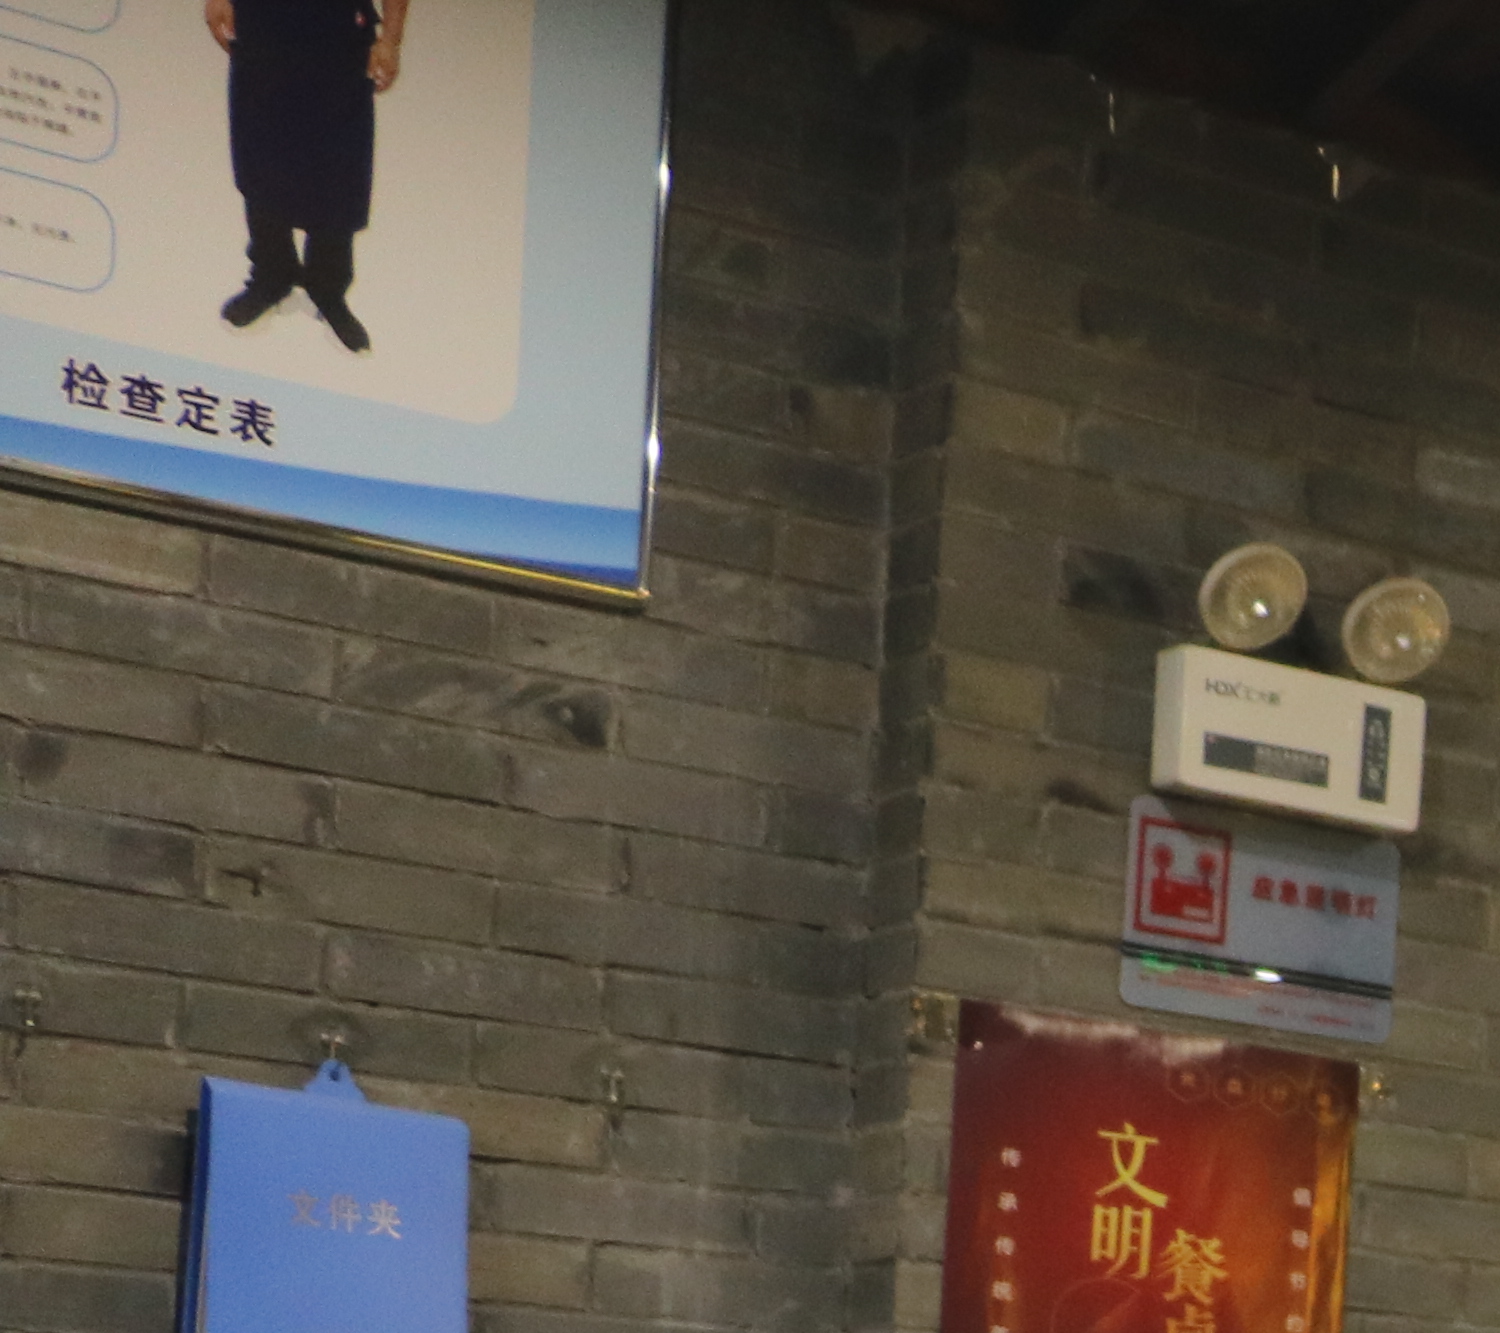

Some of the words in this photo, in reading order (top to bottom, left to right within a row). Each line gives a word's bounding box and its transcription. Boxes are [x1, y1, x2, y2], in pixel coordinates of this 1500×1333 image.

[61, 357, 276, 447] 检查定表
[288, 1188, 402, 1239] 文件夹
[1090, 1121, 1168, 1281] 文明
